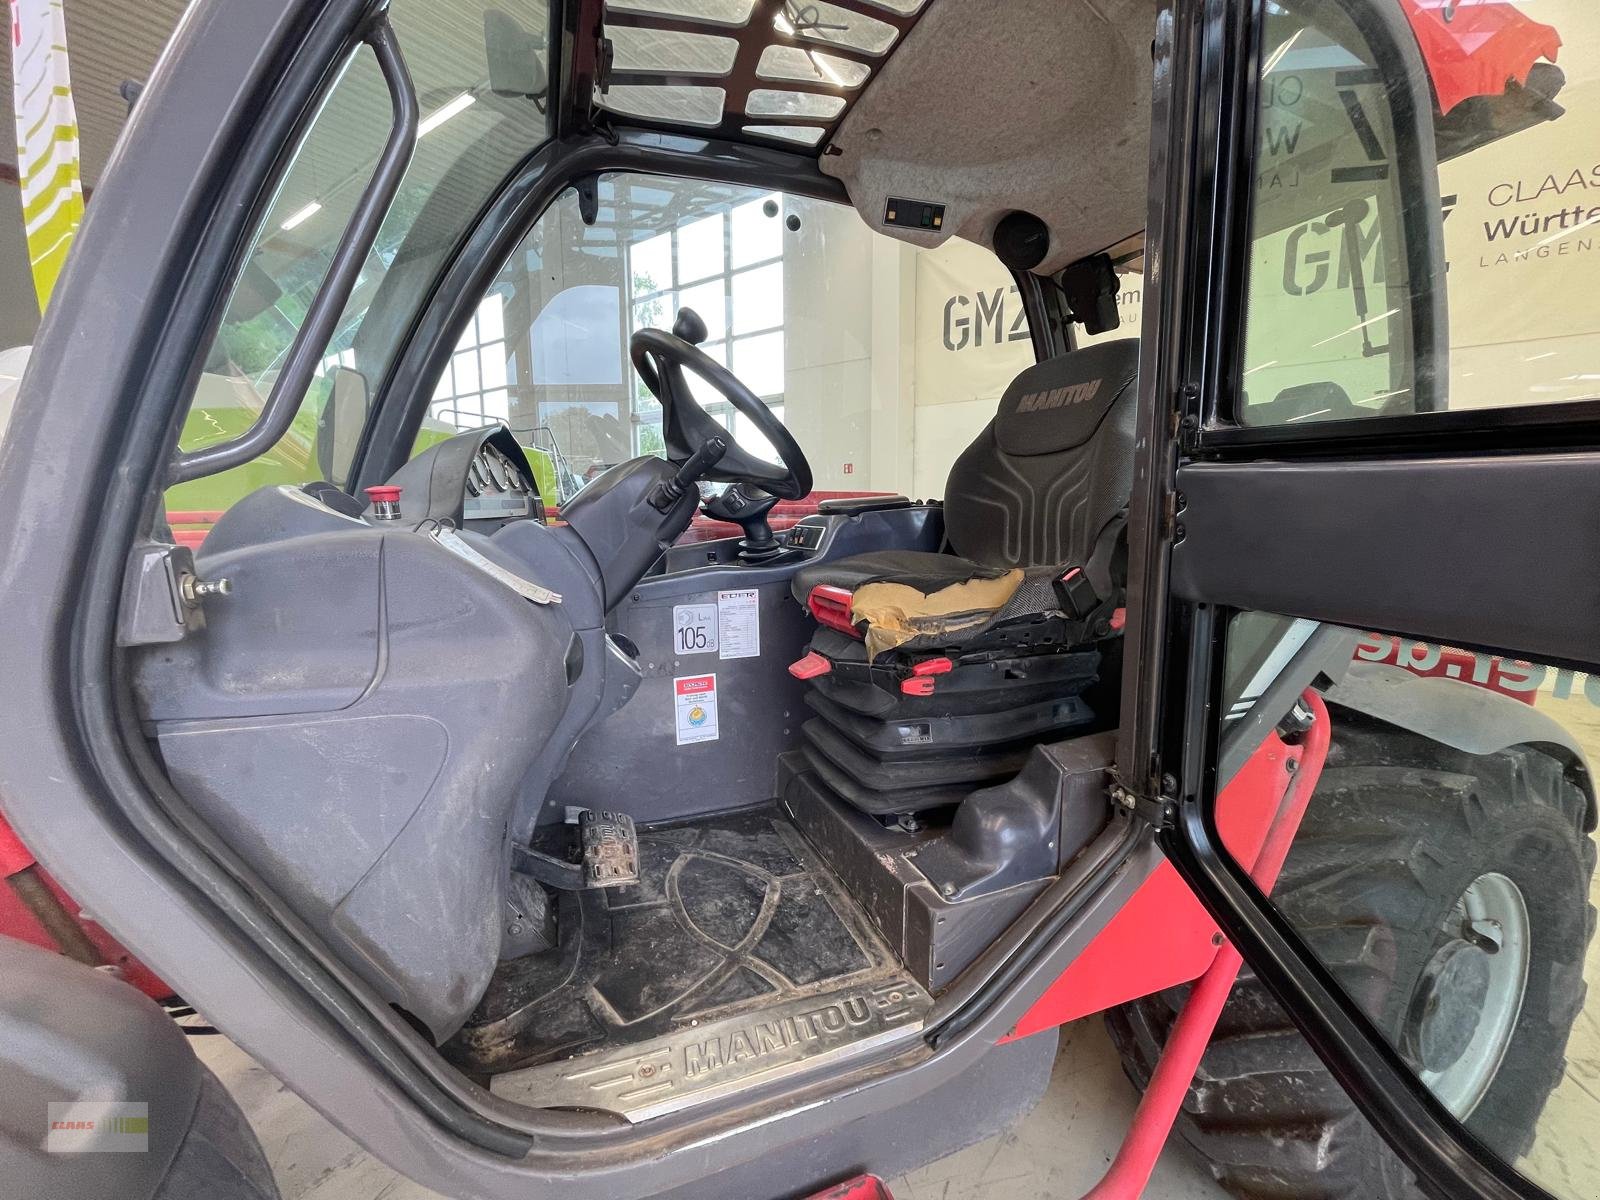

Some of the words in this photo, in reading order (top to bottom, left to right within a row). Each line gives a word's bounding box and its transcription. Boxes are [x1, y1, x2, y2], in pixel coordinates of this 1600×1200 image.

[943, 285, 1032, 351] GMZ
[1016, 378, 1103, 413] MANITOU
[678, 626, 707, 650] 105
[684, 996, 872, 1078] MANITOU
